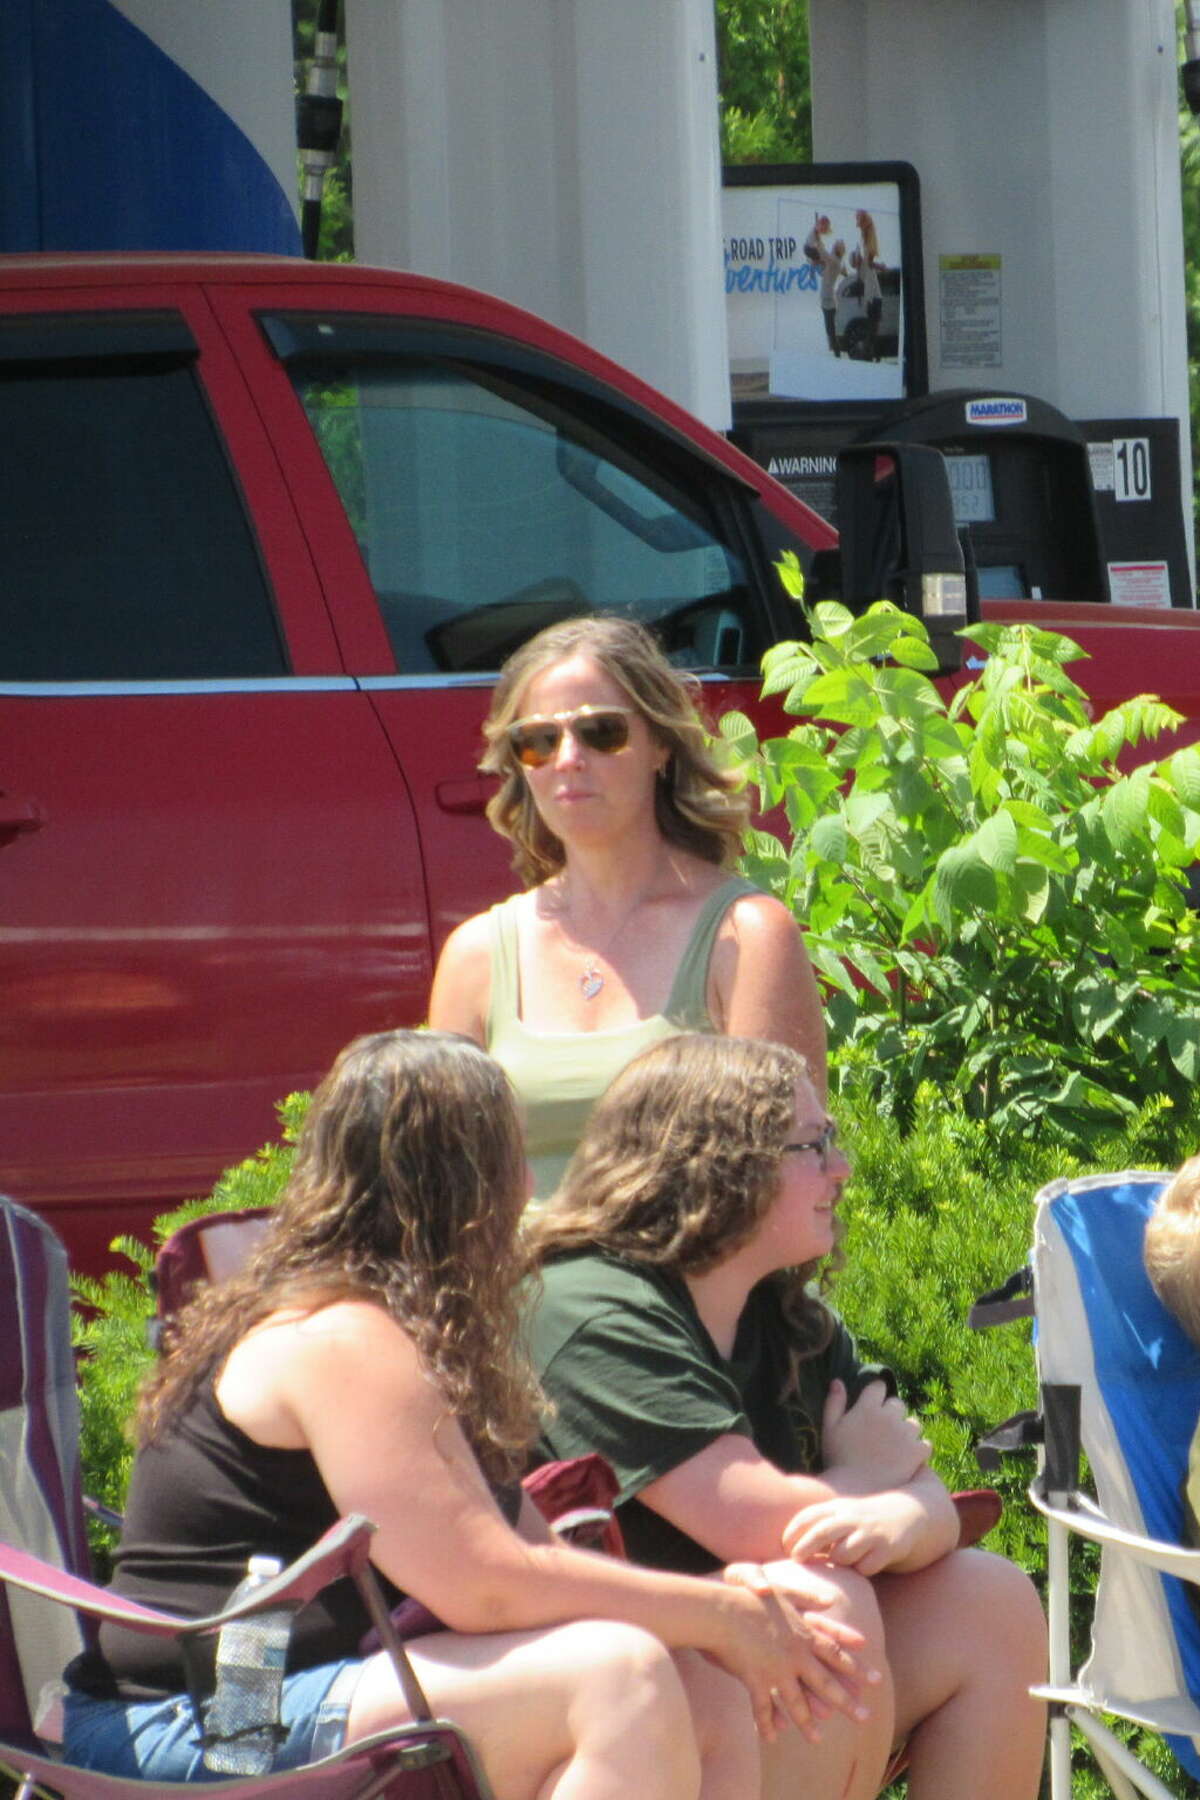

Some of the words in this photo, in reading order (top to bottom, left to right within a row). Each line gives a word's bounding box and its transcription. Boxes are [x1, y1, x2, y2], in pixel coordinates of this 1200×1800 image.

[730, 237, 765, 260] ROAD
[768, 237, 797, 260] TRIP
[969, 402, 1025, 417] MARATHON
[1116, 441, 1148, 496] 10
